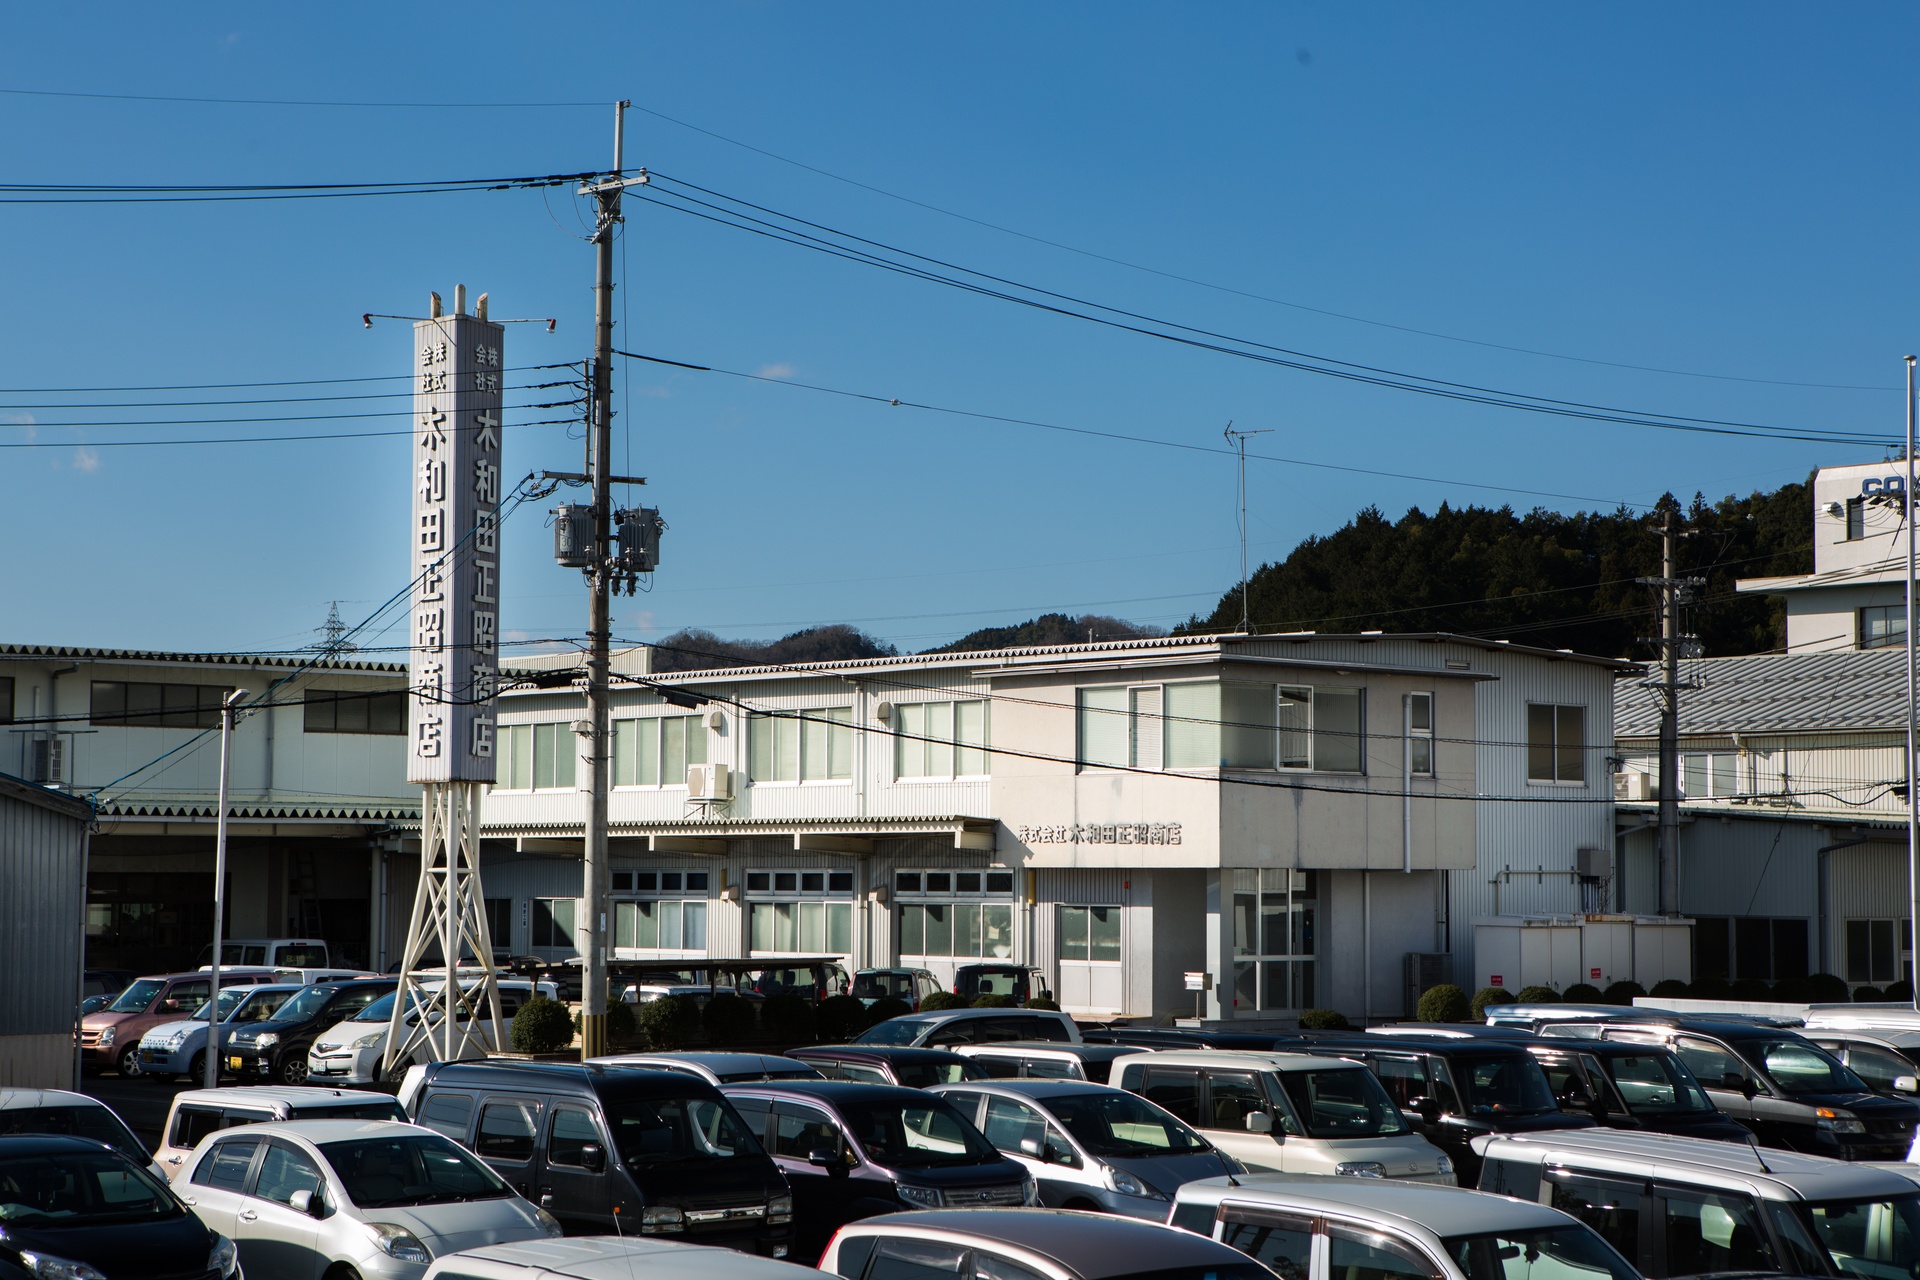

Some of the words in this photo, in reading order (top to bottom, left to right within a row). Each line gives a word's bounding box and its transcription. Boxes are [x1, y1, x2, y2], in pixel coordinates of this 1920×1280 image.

[418, 406, 446, 758] 木和田正昭商店
[473, 409, 498, 758] 木和田正昭商店
